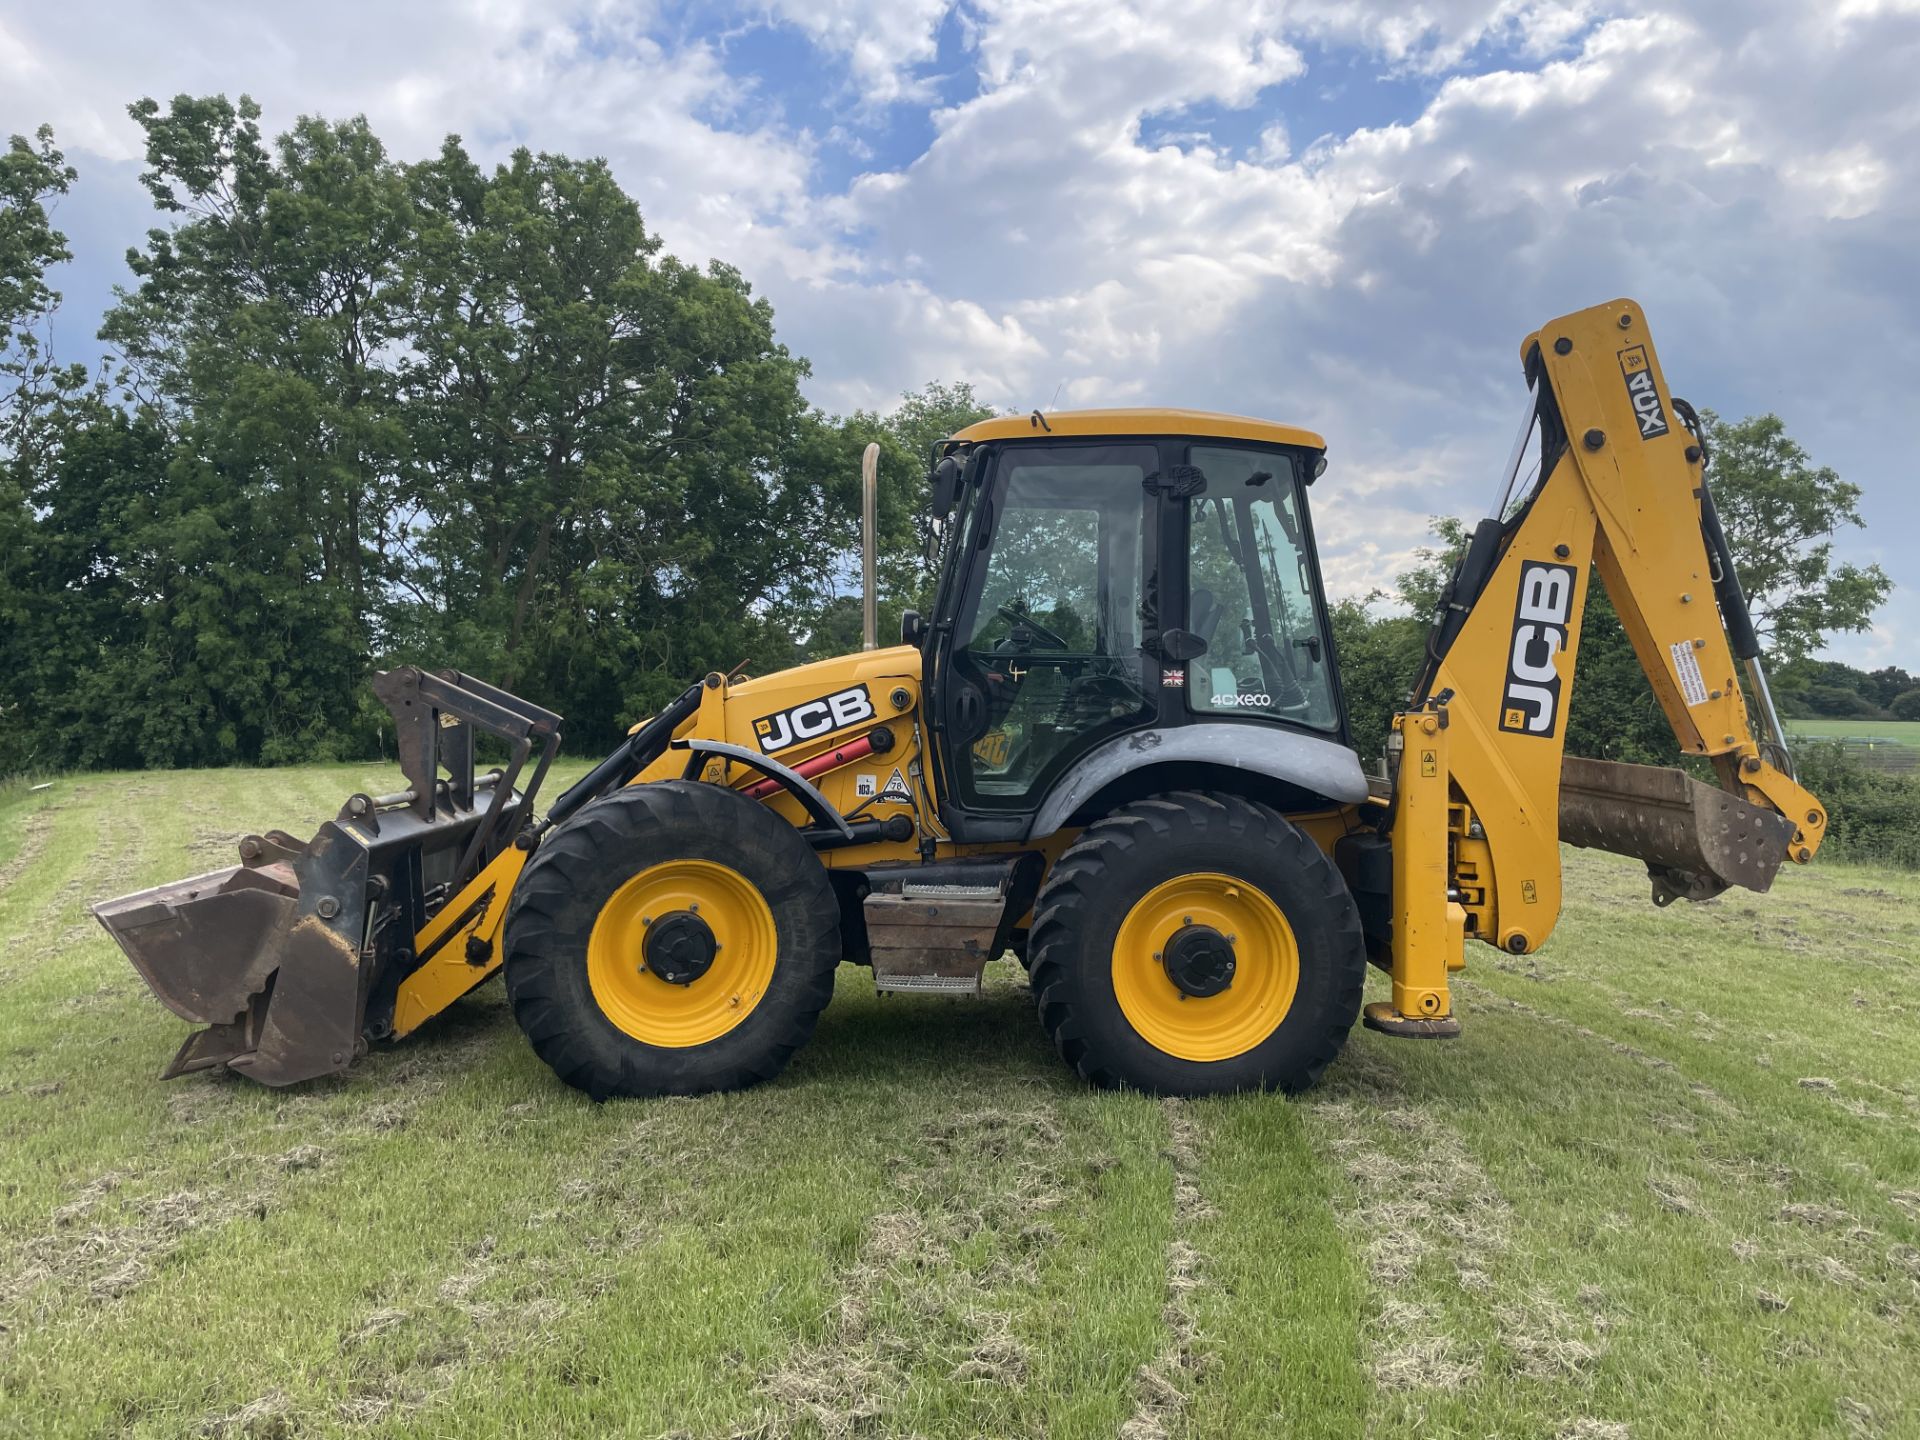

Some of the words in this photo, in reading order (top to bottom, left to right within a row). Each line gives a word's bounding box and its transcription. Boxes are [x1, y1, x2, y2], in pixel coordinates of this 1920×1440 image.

[1629, 371, 1665, 432] 4CX
[1508, 567, 1570, 732] JCB
[761, 688, 873, 751] JCB
[858, 784, 870, 795] 103
[891, 782, 902, 790] 78
